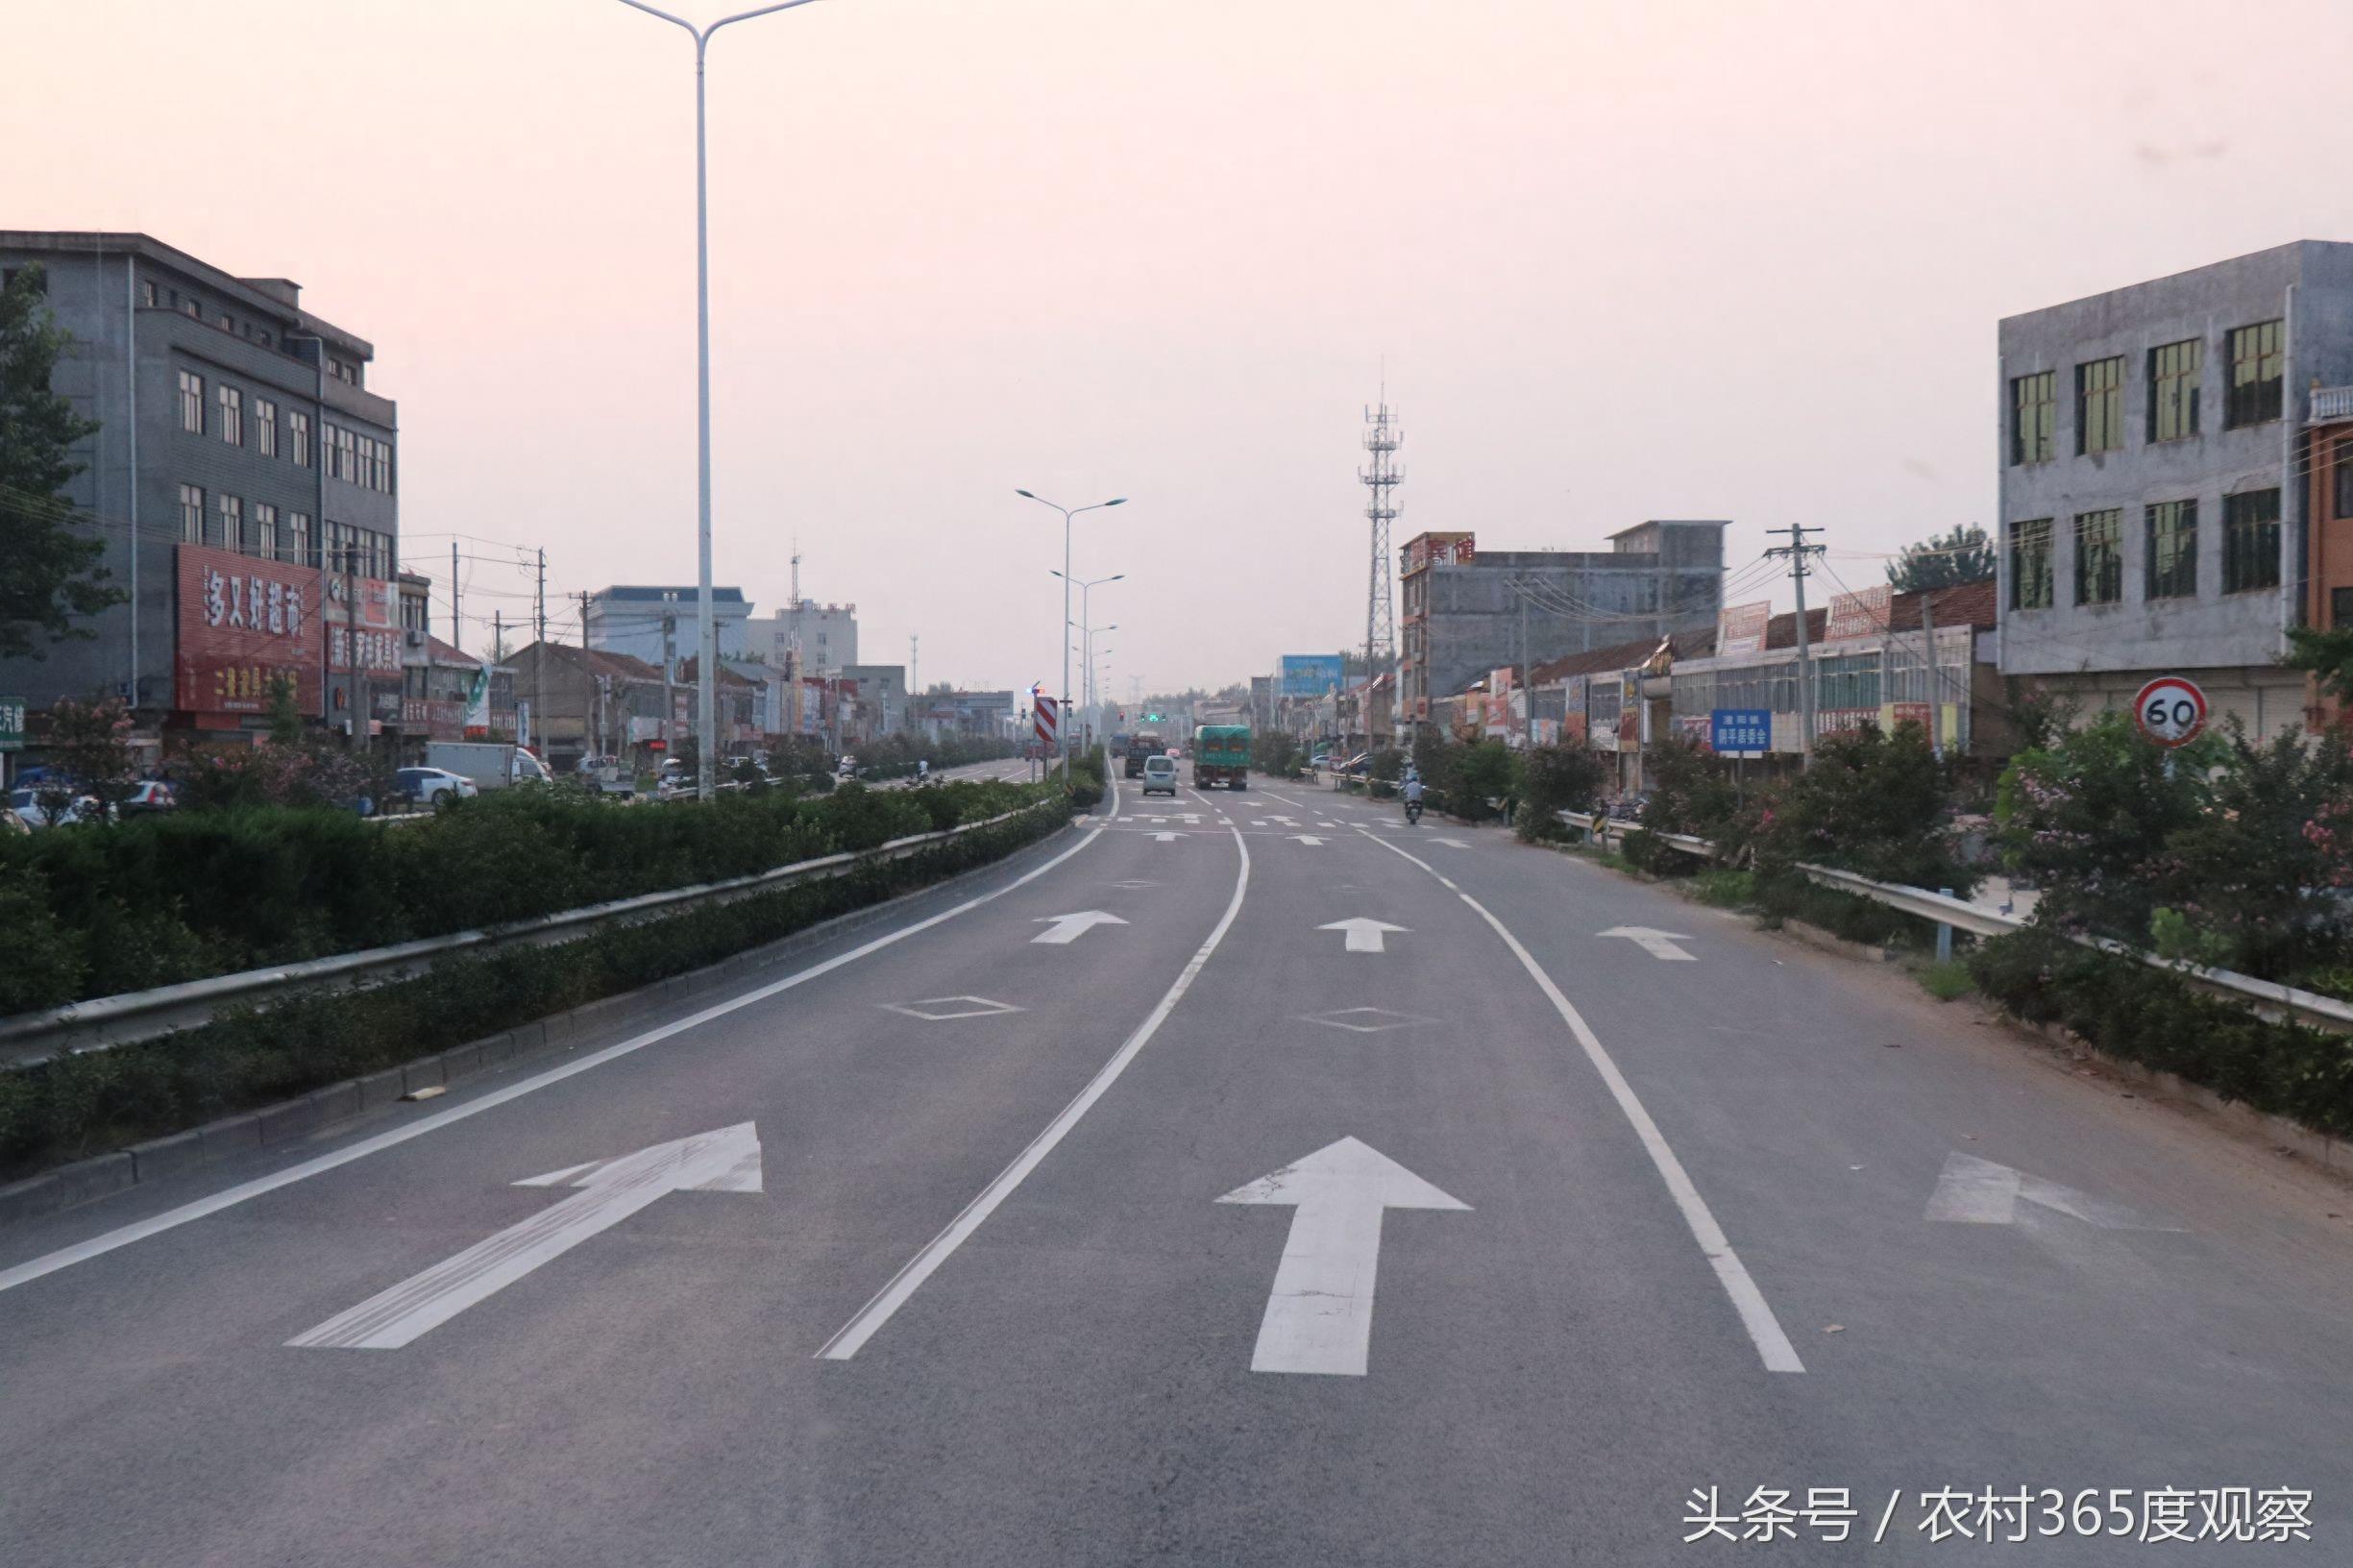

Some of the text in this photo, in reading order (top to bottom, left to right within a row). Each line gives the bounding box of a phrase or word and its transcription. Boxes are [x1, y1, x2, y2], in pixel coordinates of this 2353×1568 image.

[209, 570, 299, 637] 多又好超市
[2146, 698, 2195, 726] 60
